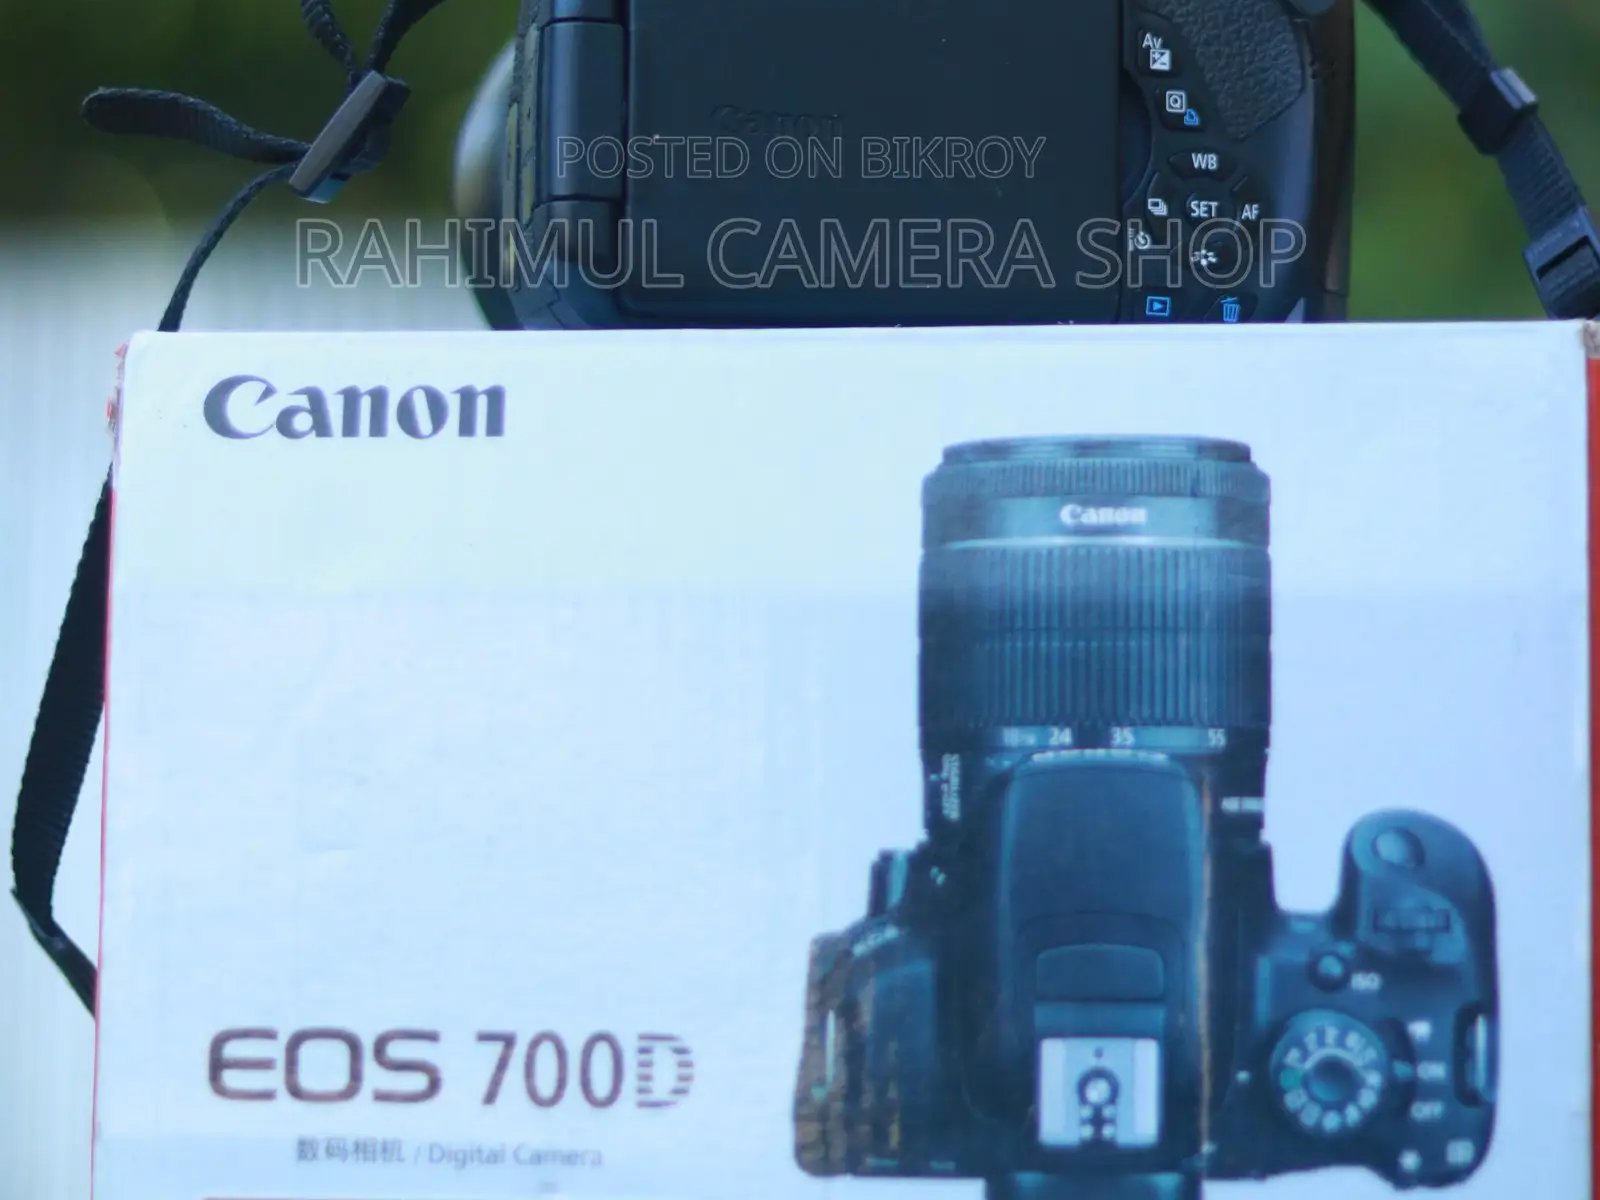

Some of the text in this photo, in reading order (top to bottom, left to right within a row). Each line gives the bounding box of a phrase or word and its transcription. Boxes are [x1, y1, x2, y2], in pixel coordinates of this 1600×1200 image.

[1142, 32, 1163, 49] Av
[1191, 153, 1217, 170] WB
[1190, 200, 1218, 217] SET
[1241, 203, 1260, 220] AF
[203, 374, 506, 440] Canon
[1059, 503, 1147, 526] Canon
[1049, 726, 1073, 746] 24
[1111, 726, 1136, 746] 35
[1207, 728, 1227, 747] 55
[208, 1027, 695, 1109] EOS 700D
[428, 1141, 506, 1169] Digital
[513, 1144, 605, 1167] Camera
